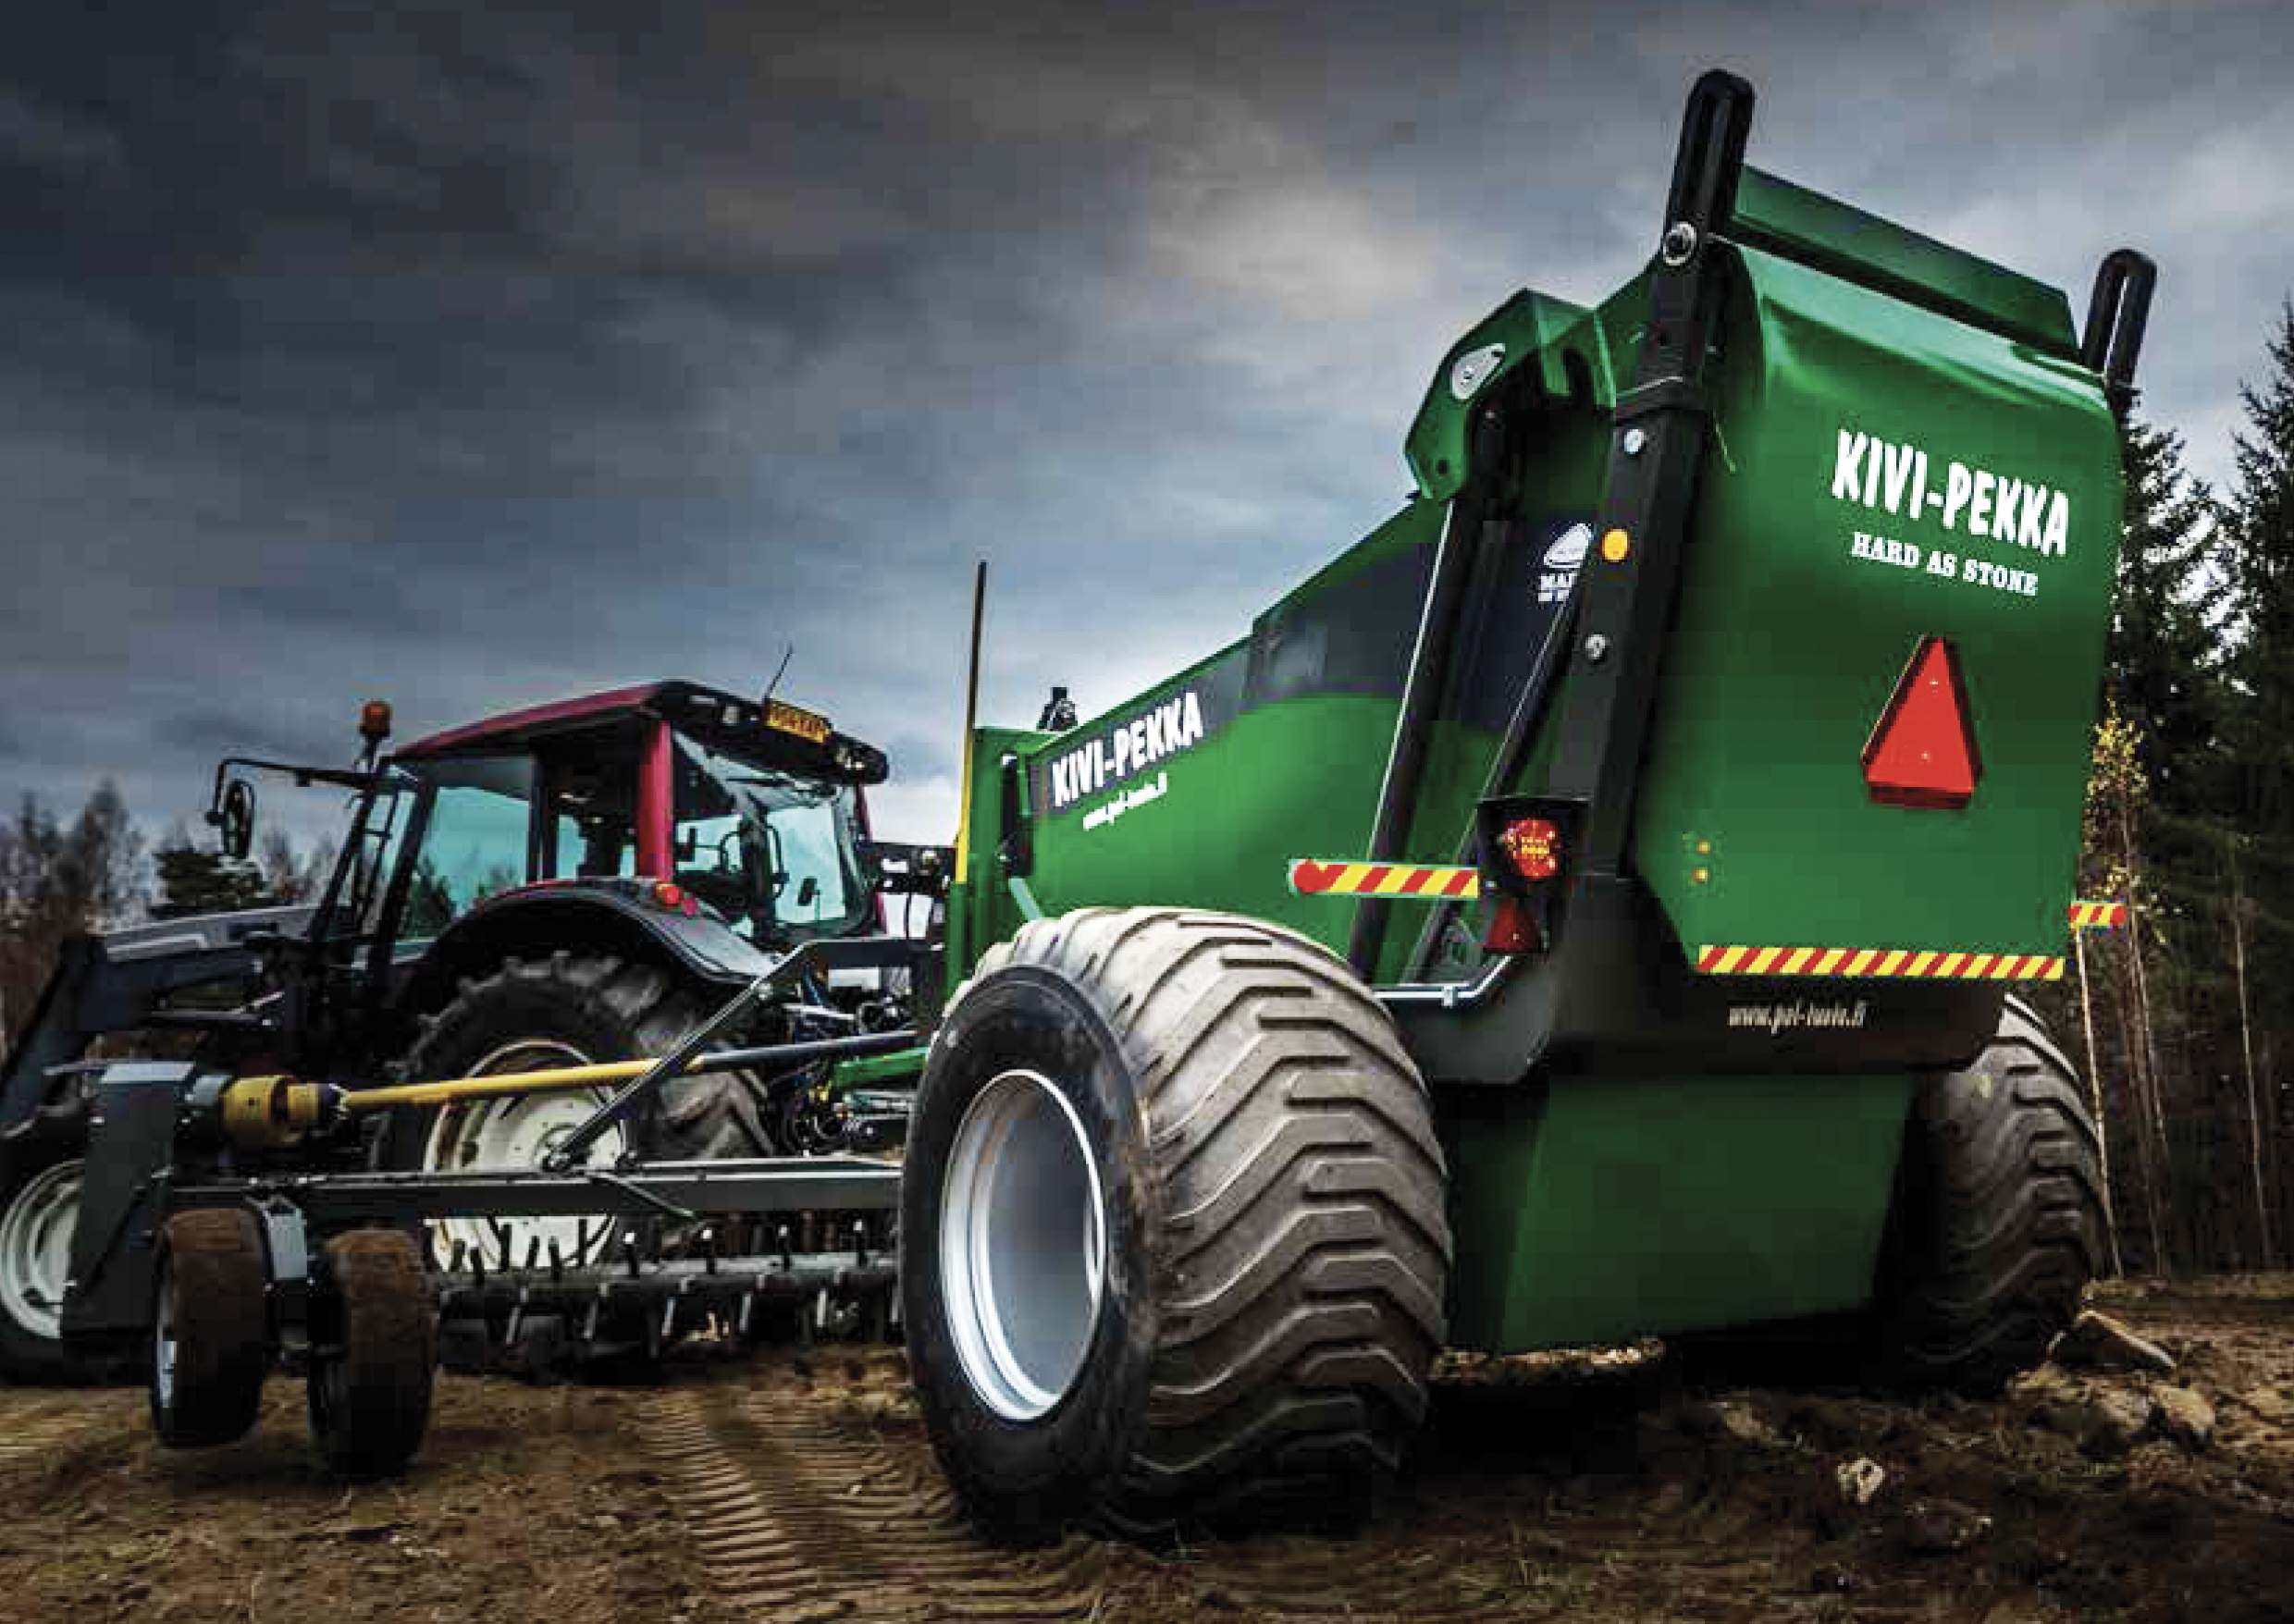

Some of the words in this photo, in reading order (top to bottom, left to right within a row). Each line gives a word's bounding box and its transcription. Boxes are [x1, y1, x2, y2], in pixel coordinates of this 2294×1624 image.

[1832, 428, 2069, 556] KIVI-PEKKA
[1852, 531, 1919, 567] HARD
[1927, 551, 1957, 577] AS
[1963, 560, 2038, 596] STONE
[1052, 692, 1203, 806] KIVI-PEKKA
